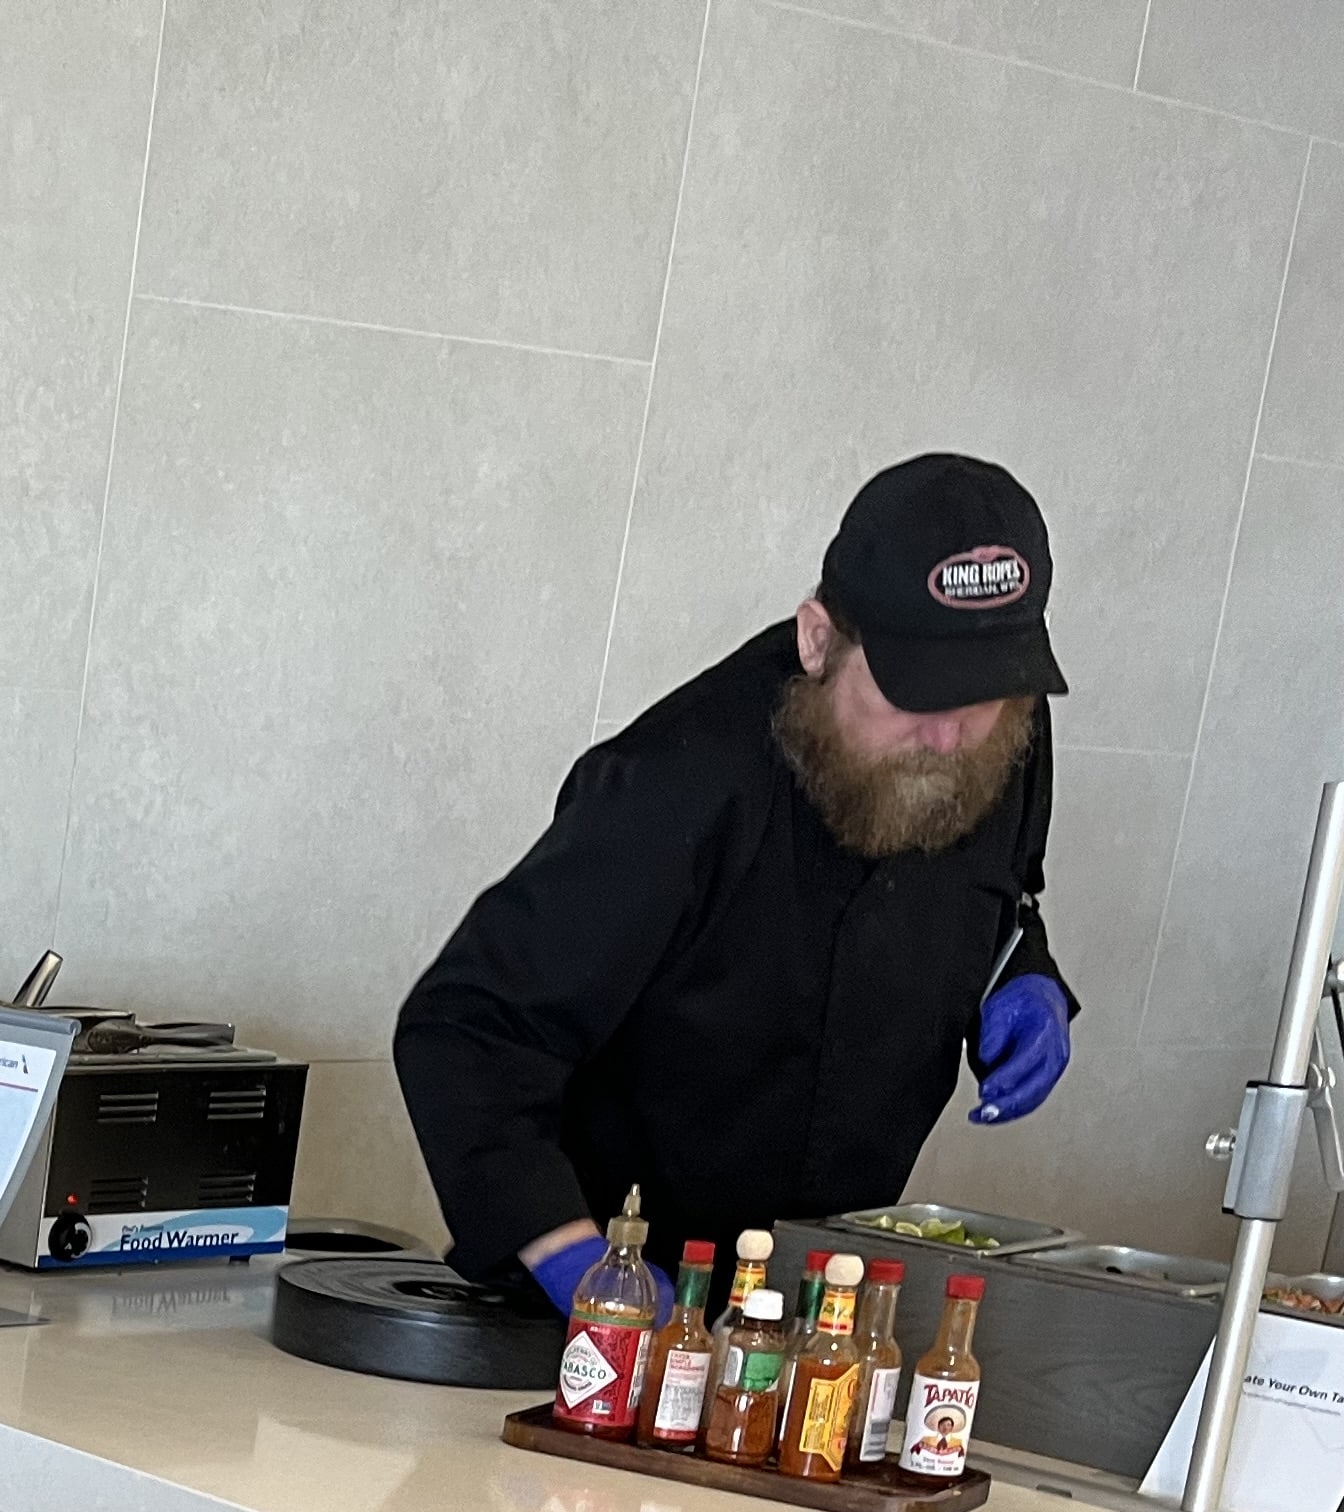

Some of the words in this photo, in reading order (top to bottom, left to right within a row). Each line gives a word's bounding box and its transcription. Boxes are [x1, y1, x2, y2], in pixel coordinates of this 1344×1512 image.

[942, 563, 980, 587] KING
[120, 1231, 163, 1251] Food
[166, 1229, 239, 1249] Warmer
[563, 1361, 607, 1380] ABASCO
[1268, 1377, 1297, 1393] Your
[1298, 1384, 1328, 1401] Own
